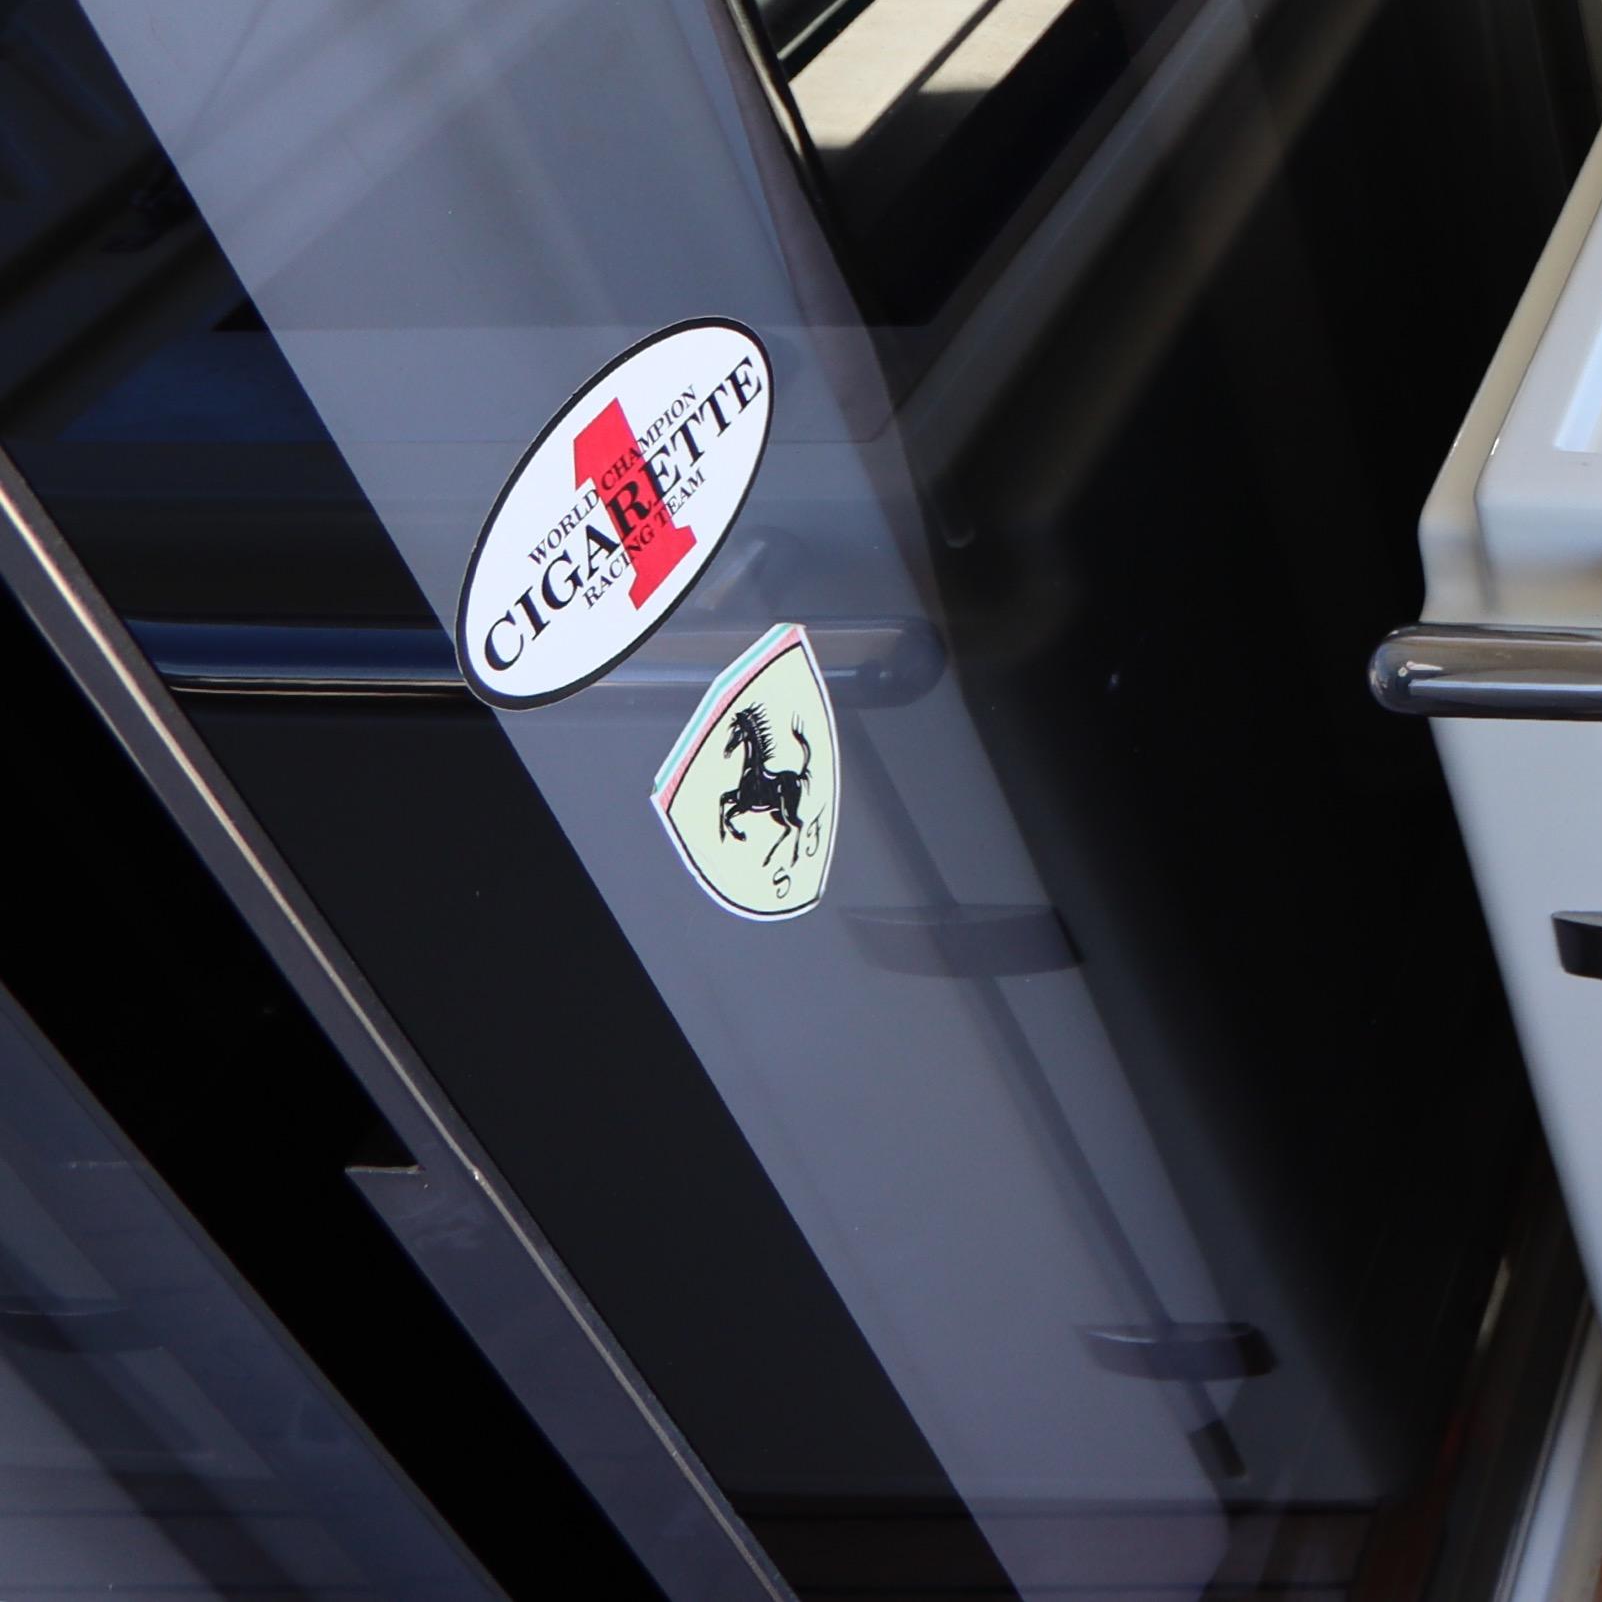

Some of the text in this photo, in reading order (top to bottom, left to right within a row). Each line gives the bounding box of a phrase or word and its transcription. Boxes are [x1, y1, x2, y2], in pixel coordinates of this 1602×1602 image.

[484, 356, 762, 672] CIGARETTE
[527, 384, 698, 567] WORLD CHAMPION
[581, 467, 706, 610] RACING TEAM
[773, 866, 791, 899] S
